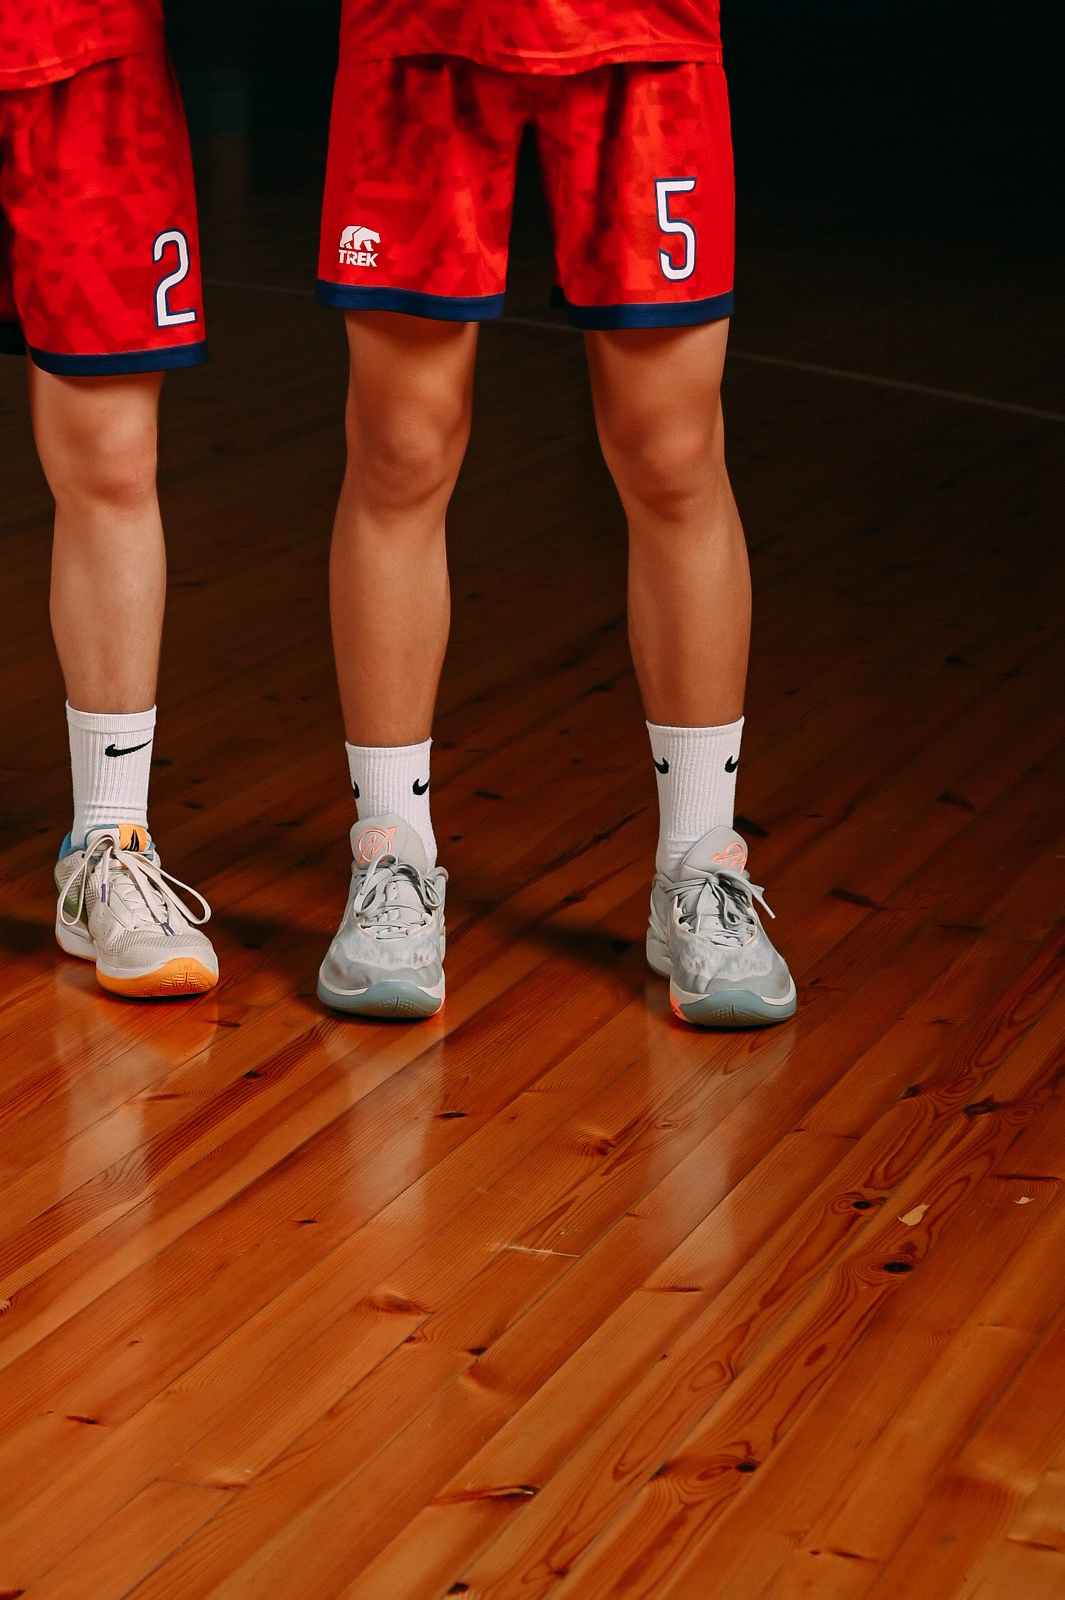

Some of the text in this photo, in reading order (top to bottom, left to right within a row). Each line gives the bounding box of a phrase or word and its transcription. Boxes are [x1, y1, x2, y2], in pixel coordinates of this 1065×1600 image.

[151, 226, 198, 329] 2
[338, 249, 380, 268] TREK
[654, 176, 697, 282] 5
